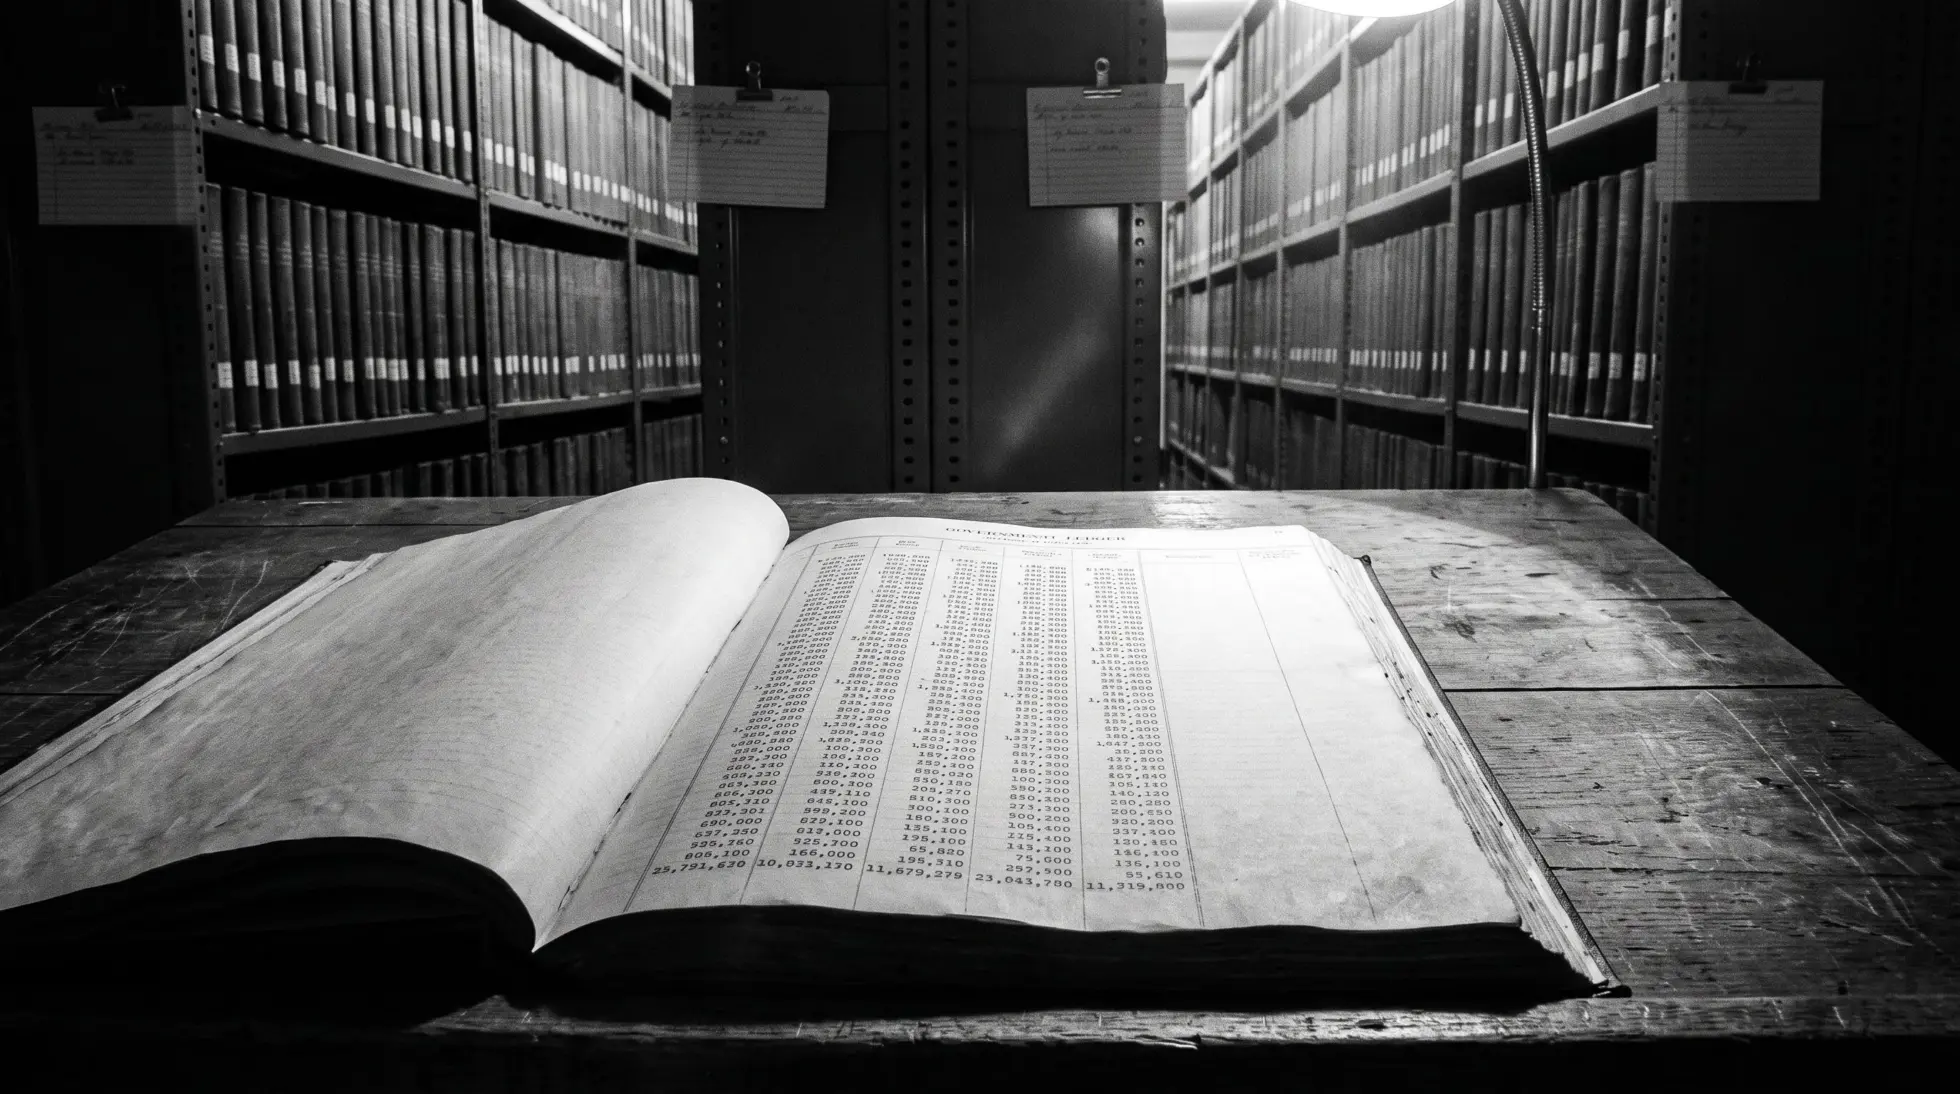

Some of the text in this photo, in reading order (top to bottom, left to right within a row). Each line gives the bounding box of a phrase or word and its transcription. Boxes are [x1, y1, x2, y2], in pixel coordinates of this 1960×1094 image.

[788, 848, 856, 859] 166,000
[1125, 871, 1183, 880] 55,610
[866, 864, 962, 879] 11,679,279
[975, 874, 1072, 888] 23,043,780
